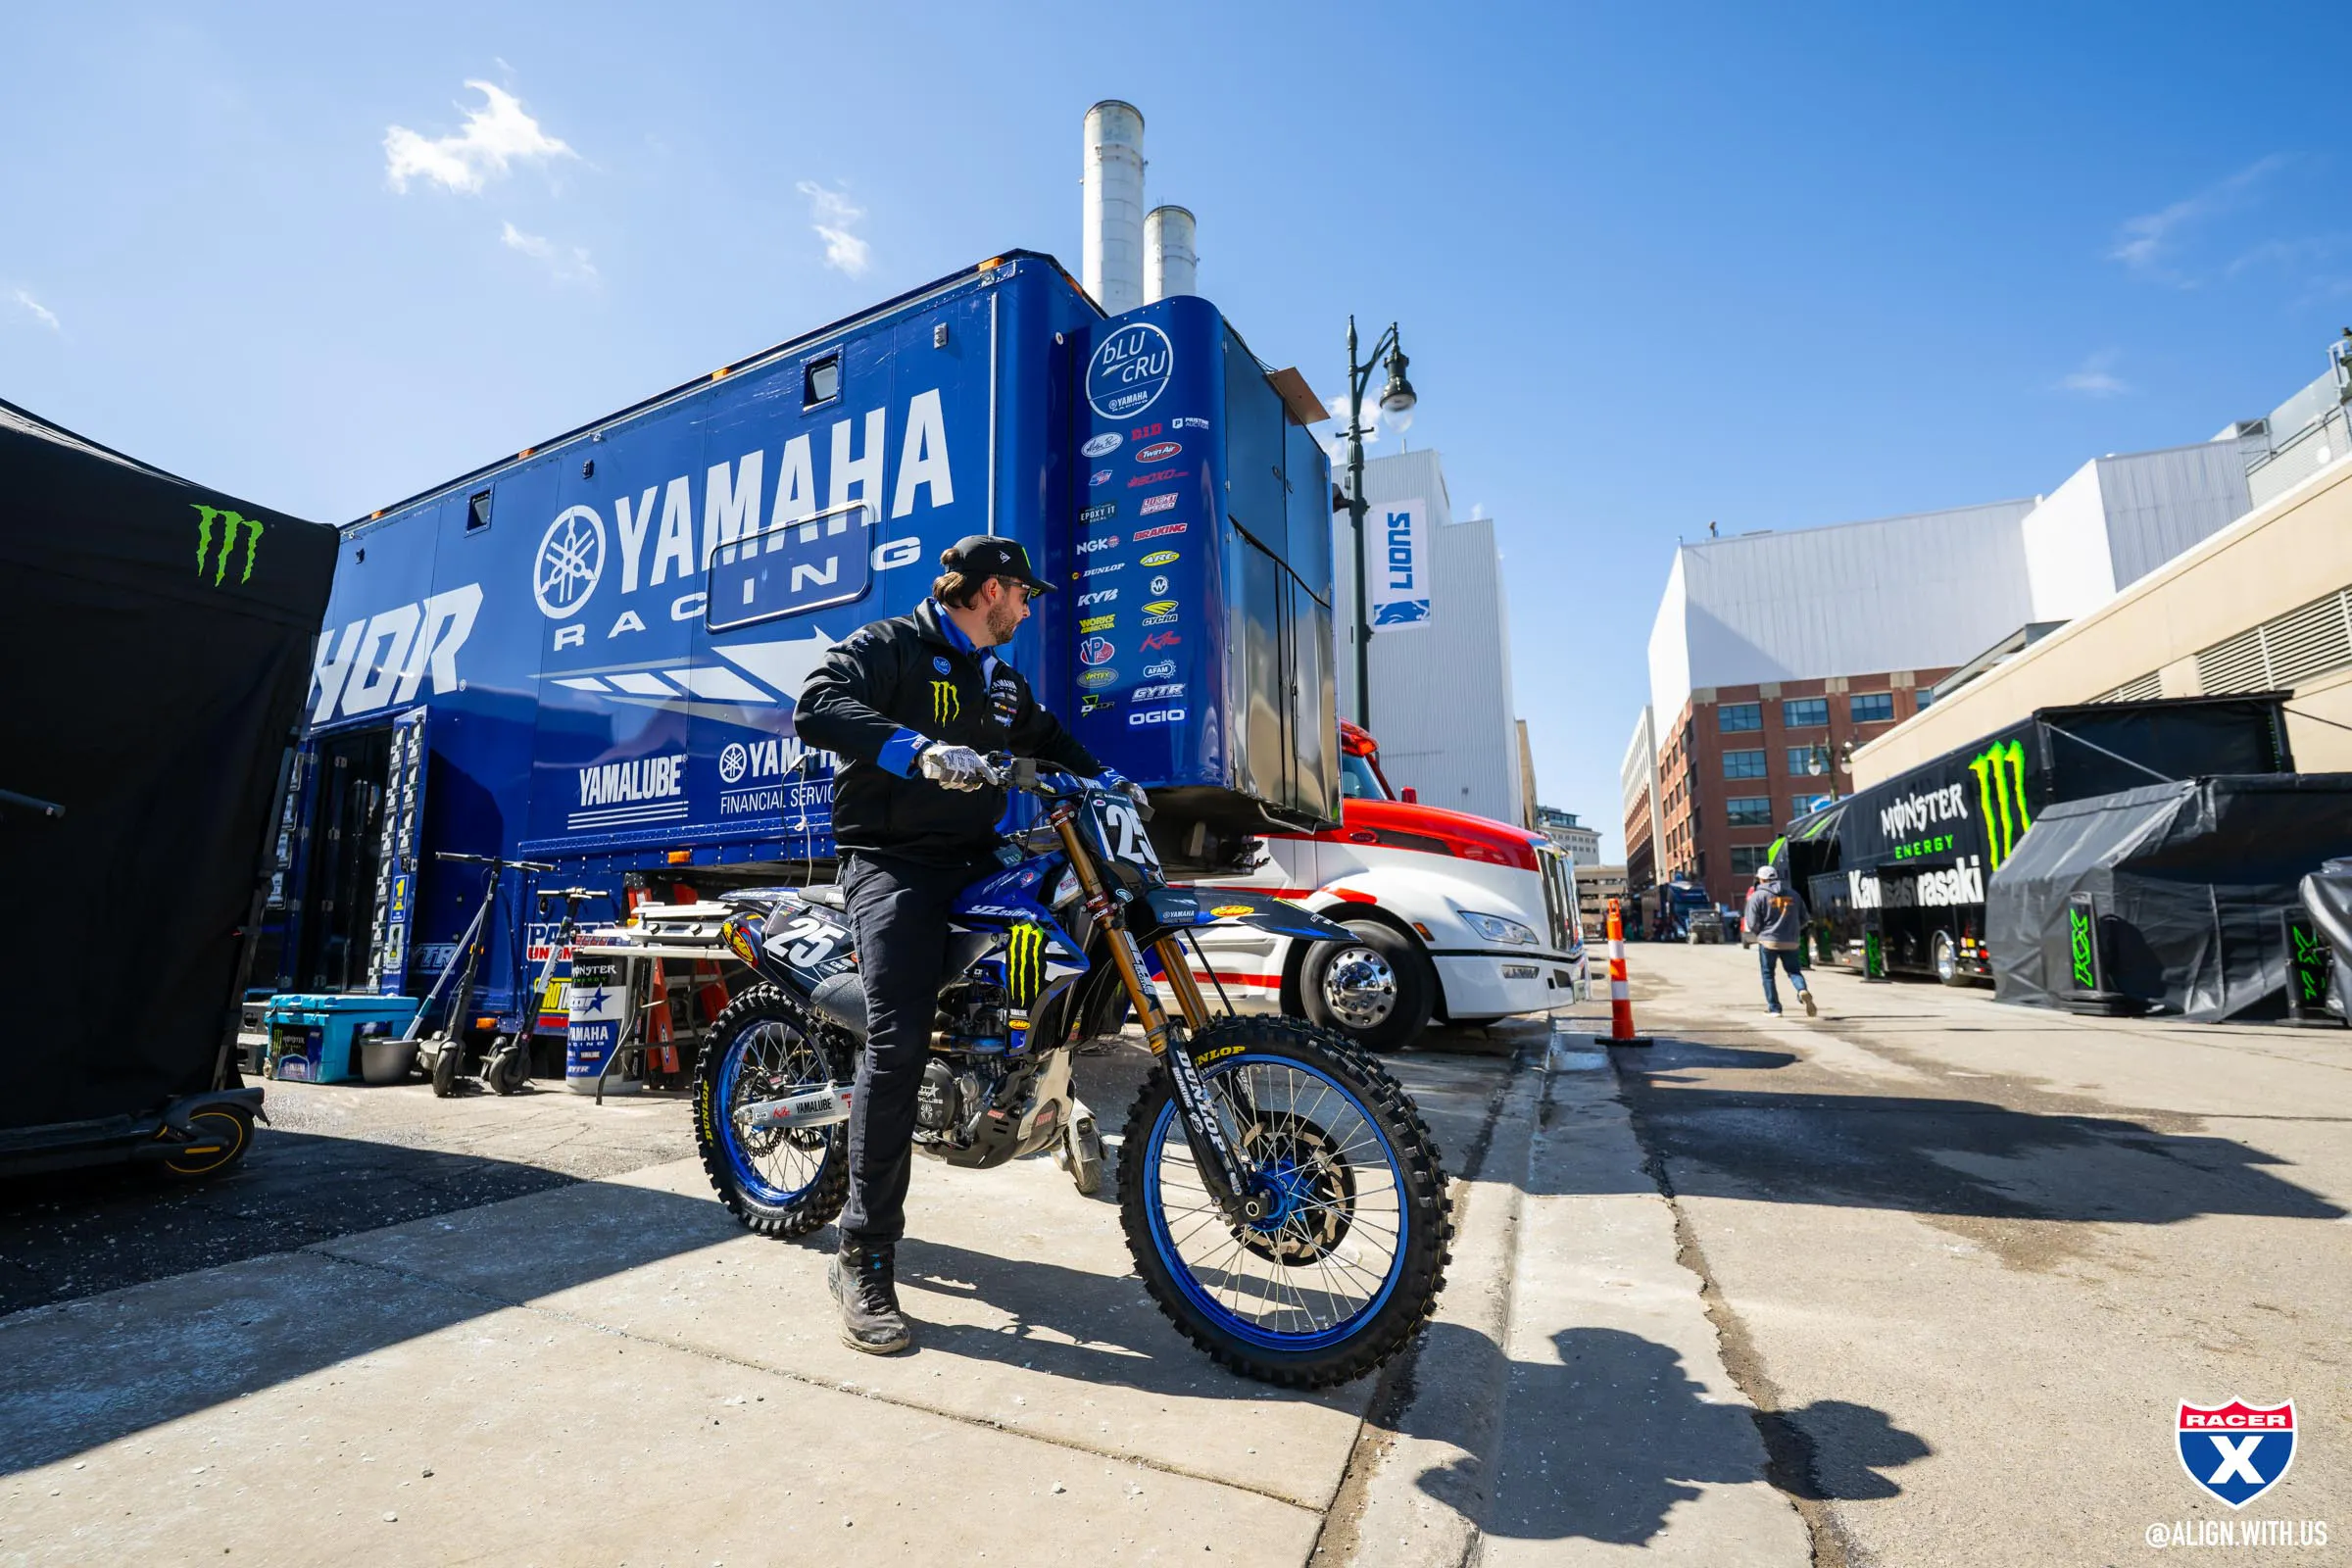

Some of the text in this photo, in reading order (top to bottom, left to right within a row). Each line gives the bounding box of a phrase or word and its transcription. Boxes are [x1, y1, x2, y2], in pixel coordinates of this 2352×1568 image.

[1117, 391, 1148, 407] YAMAHA
[1185, 416, 1209, 425] PRISTINE
[1143, 445, 1176, 459] Twin Air
[614, 388, 955, 594] YAMAHA
[1080, 508, 1105, 522] EPOXY
[1107, 505, 1115, 514] IT
[1133, 523, 1187, 542] BRAKING
[1076, 537, 1109, 556] NGK
[1387, 512, 1414, 590] LIONS
[1144, 552, 1177, 564] ARC
[1082, 563, 1126, 578] DUNLOP
[554, 536, 922, 652] RACING
[1077, 588, 1119, 607] KYB
[1079, 613, 1116, 627] WORKS
[306, 582, 484, 724] HOR
[1132, 683, 1187, 700] GYTR
[1128, 709, 1186, 725] OGIO
[580, 754, 682, 807] YAMALUBE
[720, 783, 834, 815] FINANCIAL SERVIC
[1880, 782, 1968, 840] MONSTER
[1894, 834, 1954, 859] ENERGY
[762, 917, 846, 968] 25
[1195, 1046, 1246, 1066] NLOP
[1171, 1066, 1195, 1109] BRAKING
[702, 1079, 713, 1141] DUNLOP
[796, 1098, 833, 1114] YAMALUBE
[1176, 1050, 1227, 1152] DUNLOP
